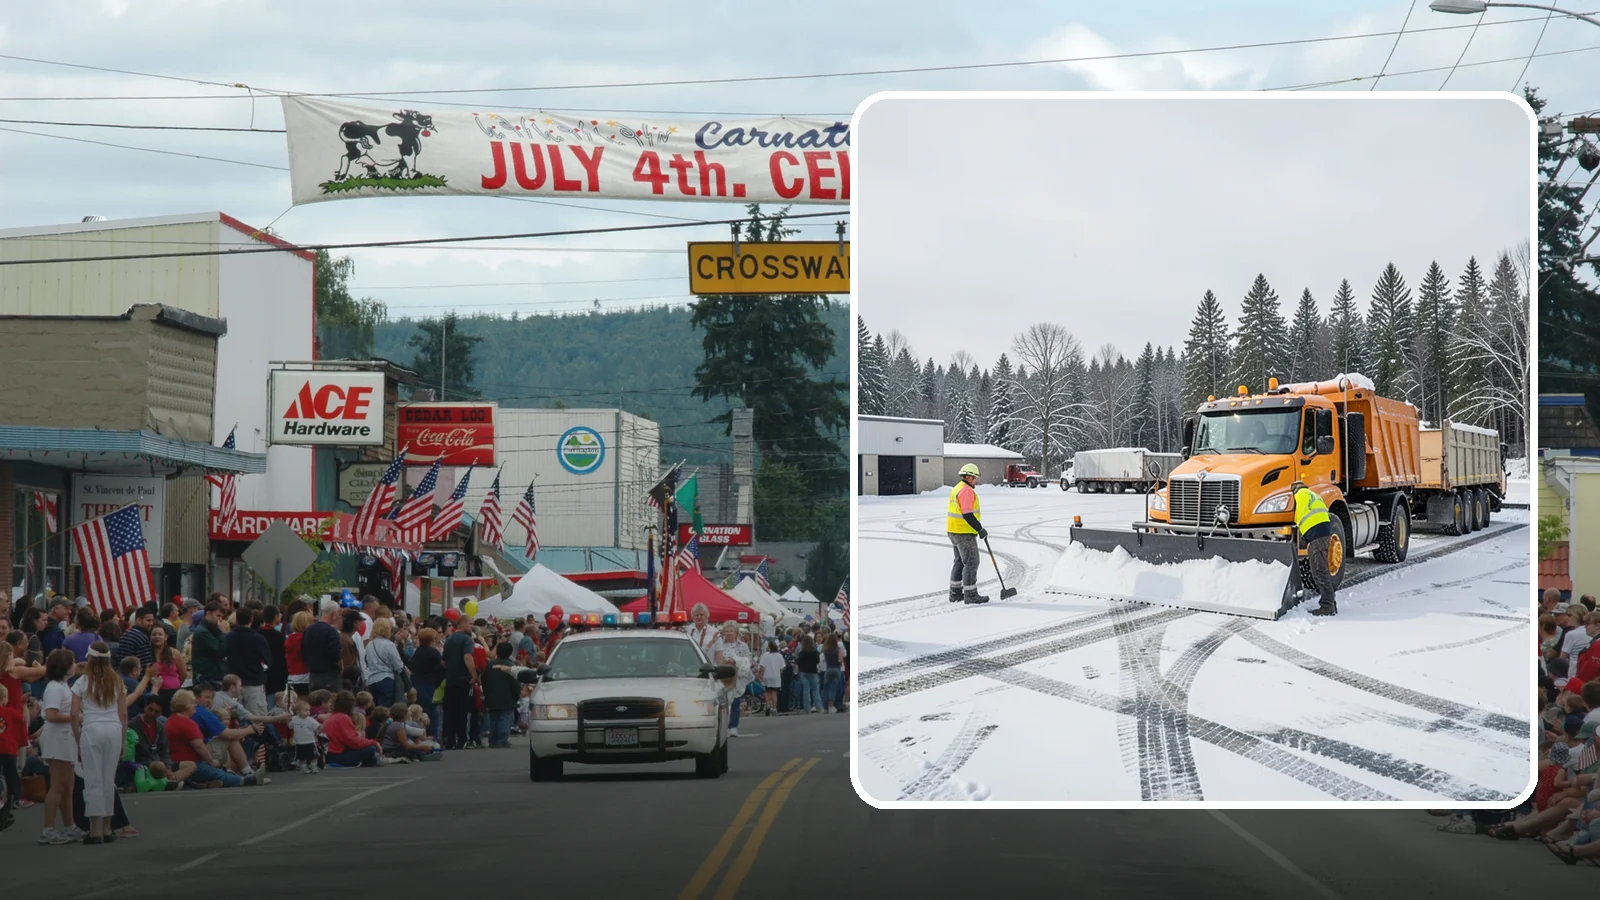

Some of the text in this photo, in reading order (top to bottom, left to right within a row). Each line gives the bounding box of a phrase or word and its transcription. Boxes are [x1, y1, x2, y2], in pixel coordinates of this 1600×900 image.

[481, 141, 605, 192] JULY
[632, 150, 747, 197] 4th.
[696, 254, 850, 280] CROSSWA
[283, 380, 373, 420] ACE
[405, 409, 485, 422] CEDAR LOG
[283, 421, 371, 437] Hardware
[416, 428, 476, 447] Coca-Cola
[353, 467, 385, 480] Simpl
[83, 485, 155, 495] St. Vincent de Paul
[80, 503, 154, 522] THT
[212, 516, 331, 536] HARDARE
[688, 526, 742, 535] CRNATION
[699, 535, 730, 543] GLASS
